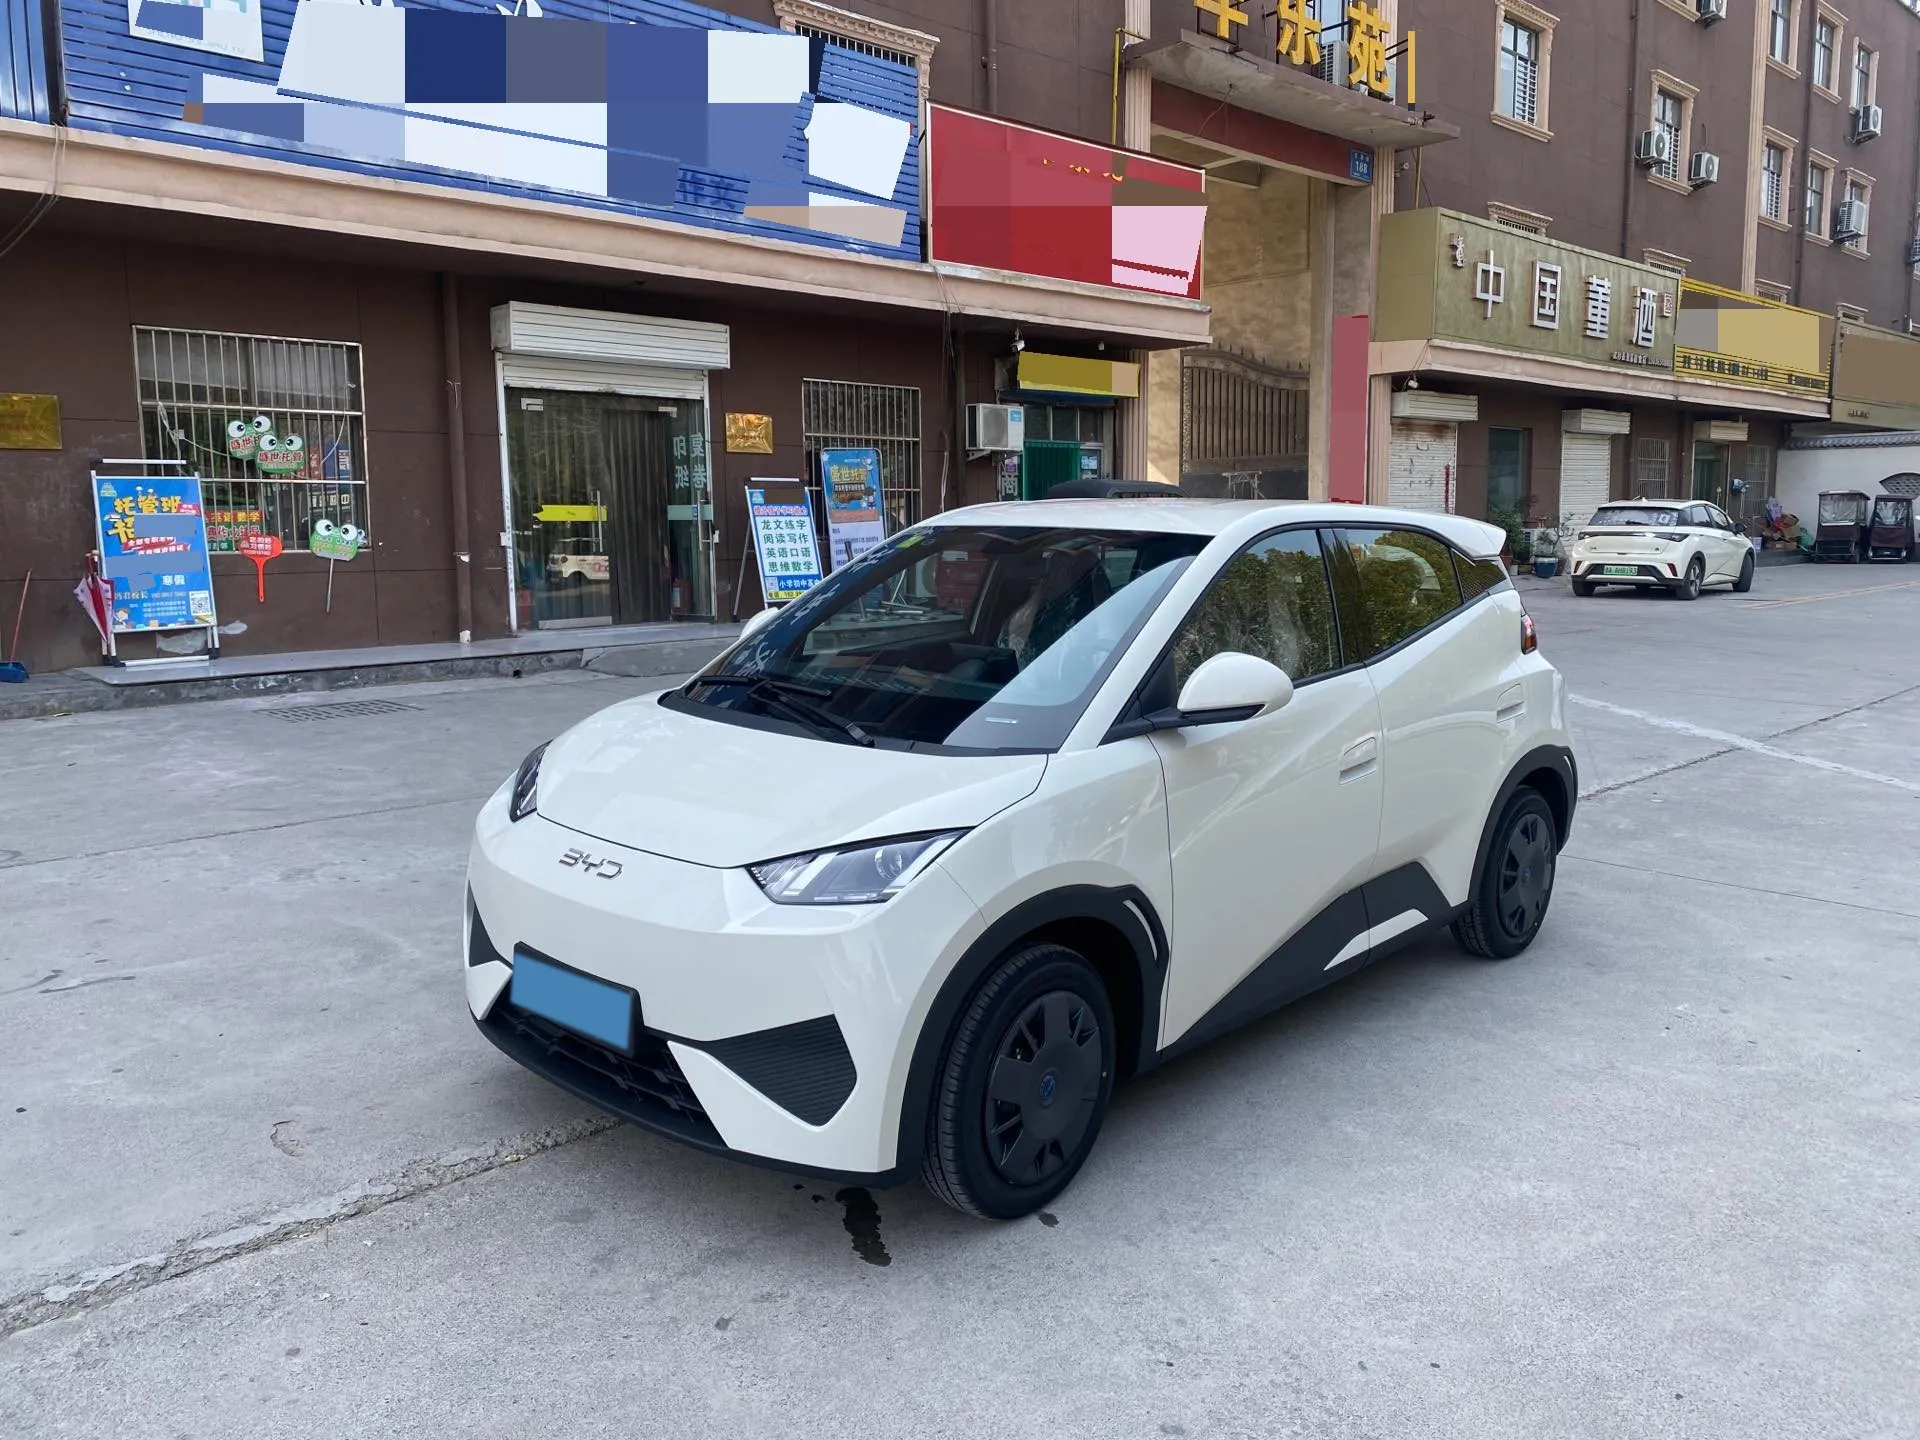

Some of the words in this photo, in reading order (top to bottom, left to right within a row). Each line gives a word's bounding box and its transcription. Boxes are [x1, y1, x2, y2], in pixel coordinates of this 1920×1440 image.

[678, 171, 736, 209] 作文
[1474, 249, 1658, 348] 中国董酒
[114, 496, 181, 516] 托管班
[761, 519, 807, 531] 龙文练字
[763, 533, 809, 545] 阅读写作
[766, 547, 811, 559] 英语口语
[768, 561, 813, 572] 思维数学
[559, 848, 623, 879] BYD
